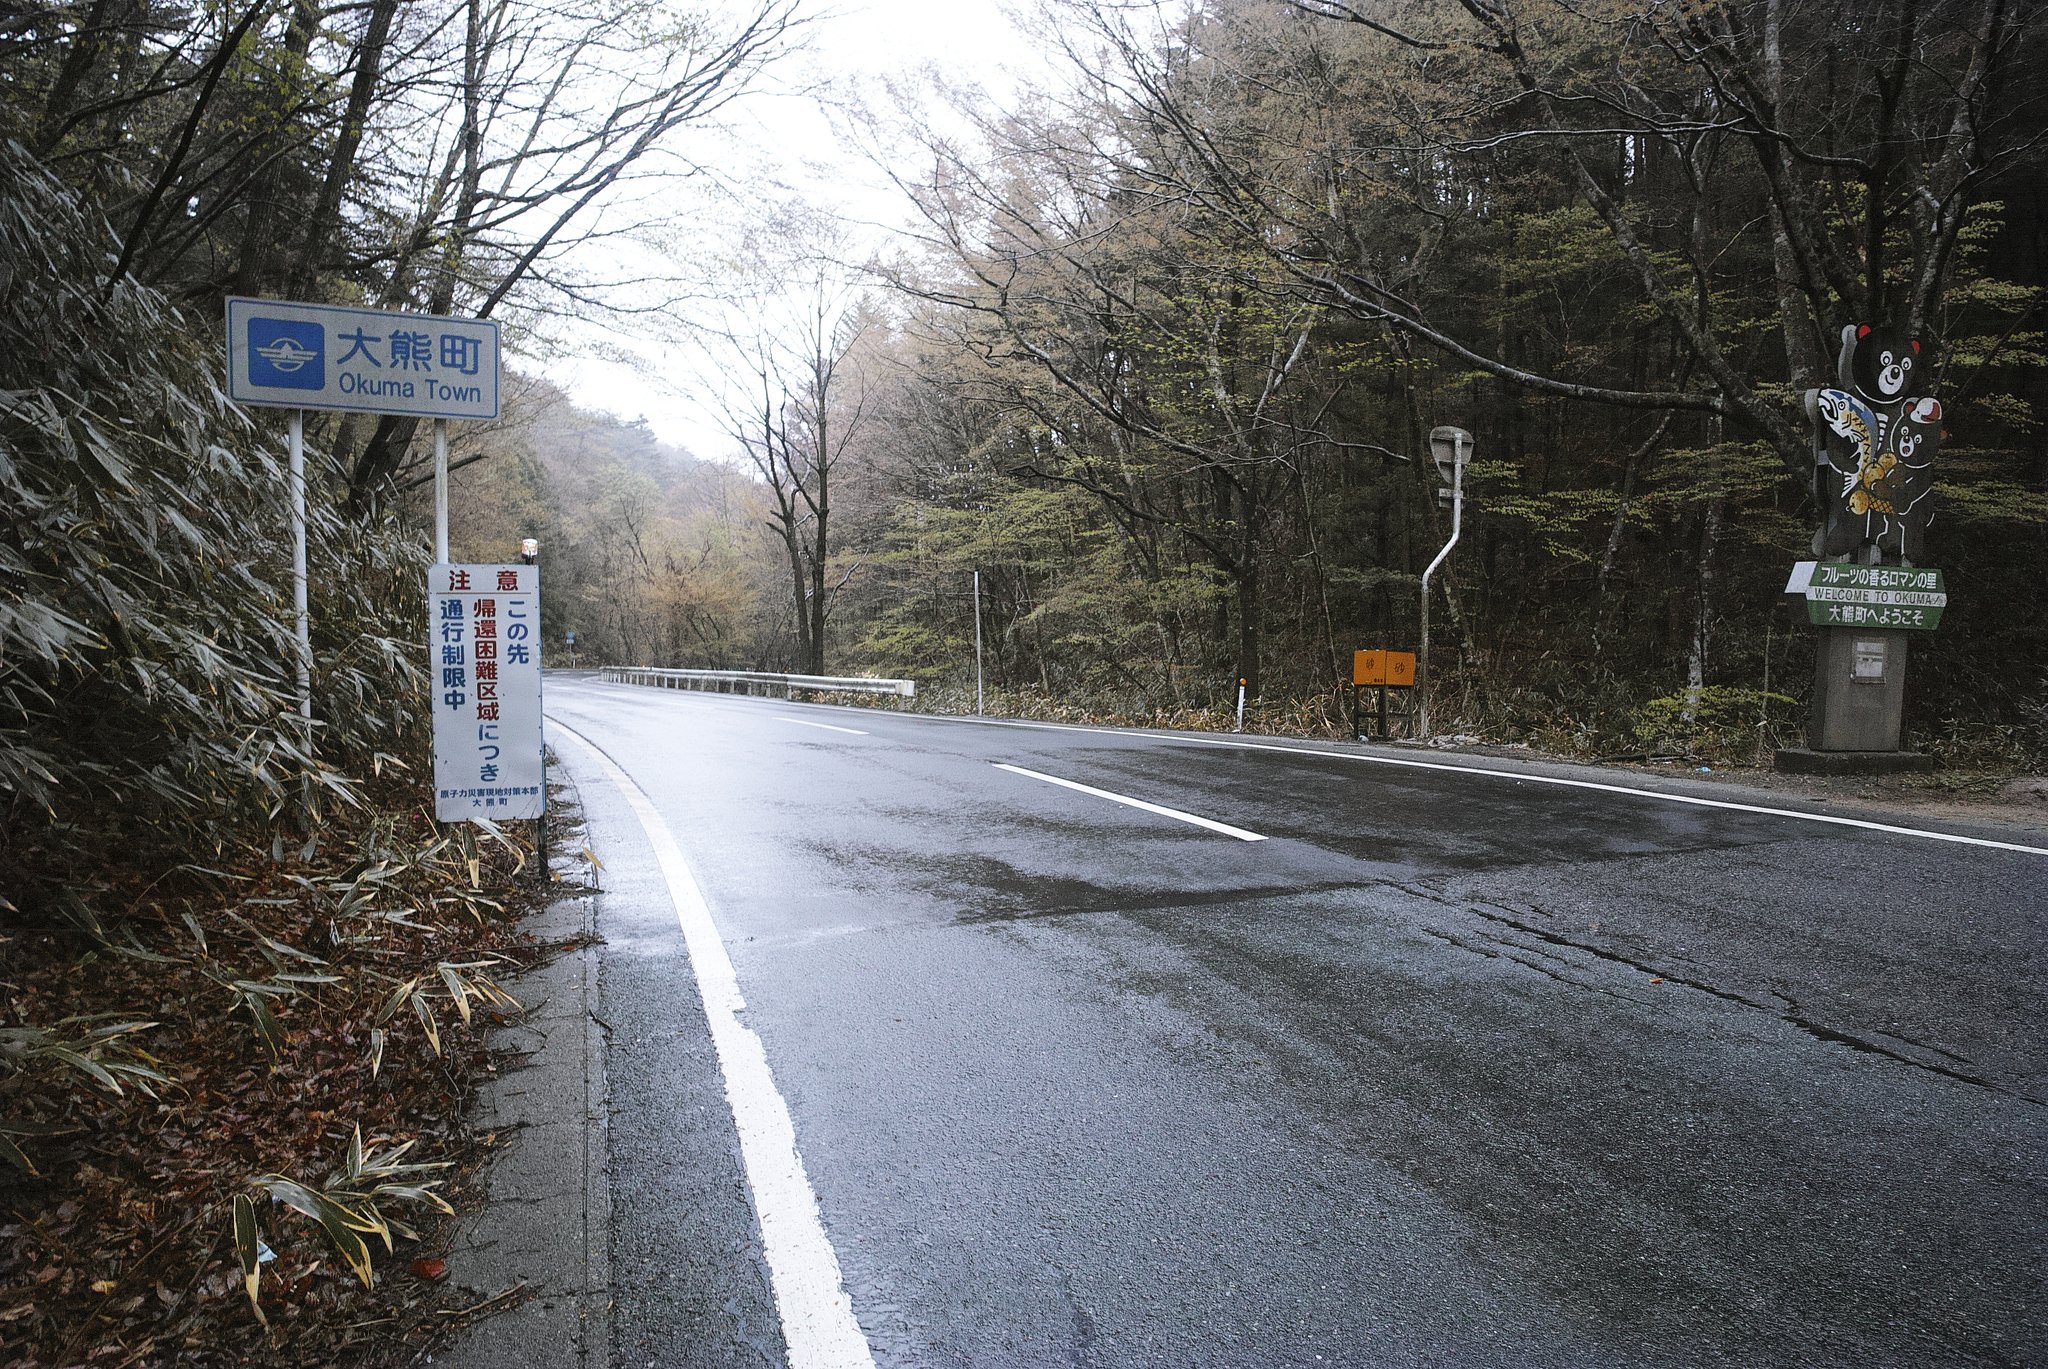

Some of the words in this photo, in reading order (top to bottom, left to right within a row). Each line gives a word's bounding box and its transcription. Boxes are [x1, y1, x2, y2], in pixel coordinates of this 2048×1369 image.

[337, 327, 482, 375] 大熊町
[339, 372, 415, 398] Okuma
[425, 379, 481, 402] Town
[1815, 588, 1869, 601] WELCOME
[1875, 591, 1888, 602] TO
[1894, 593, 1932, 605] OKUMA
[1821, 566, 1937, 589] フルーツの香るロマンの里
[507, 601, 529, 665] この先
[1828, 605, 1924, 626] 大熊町へようこそ
[441, 599, 466, 711] 通行制限中
[474, 599, 500, 782] 帰還困難区域につき
